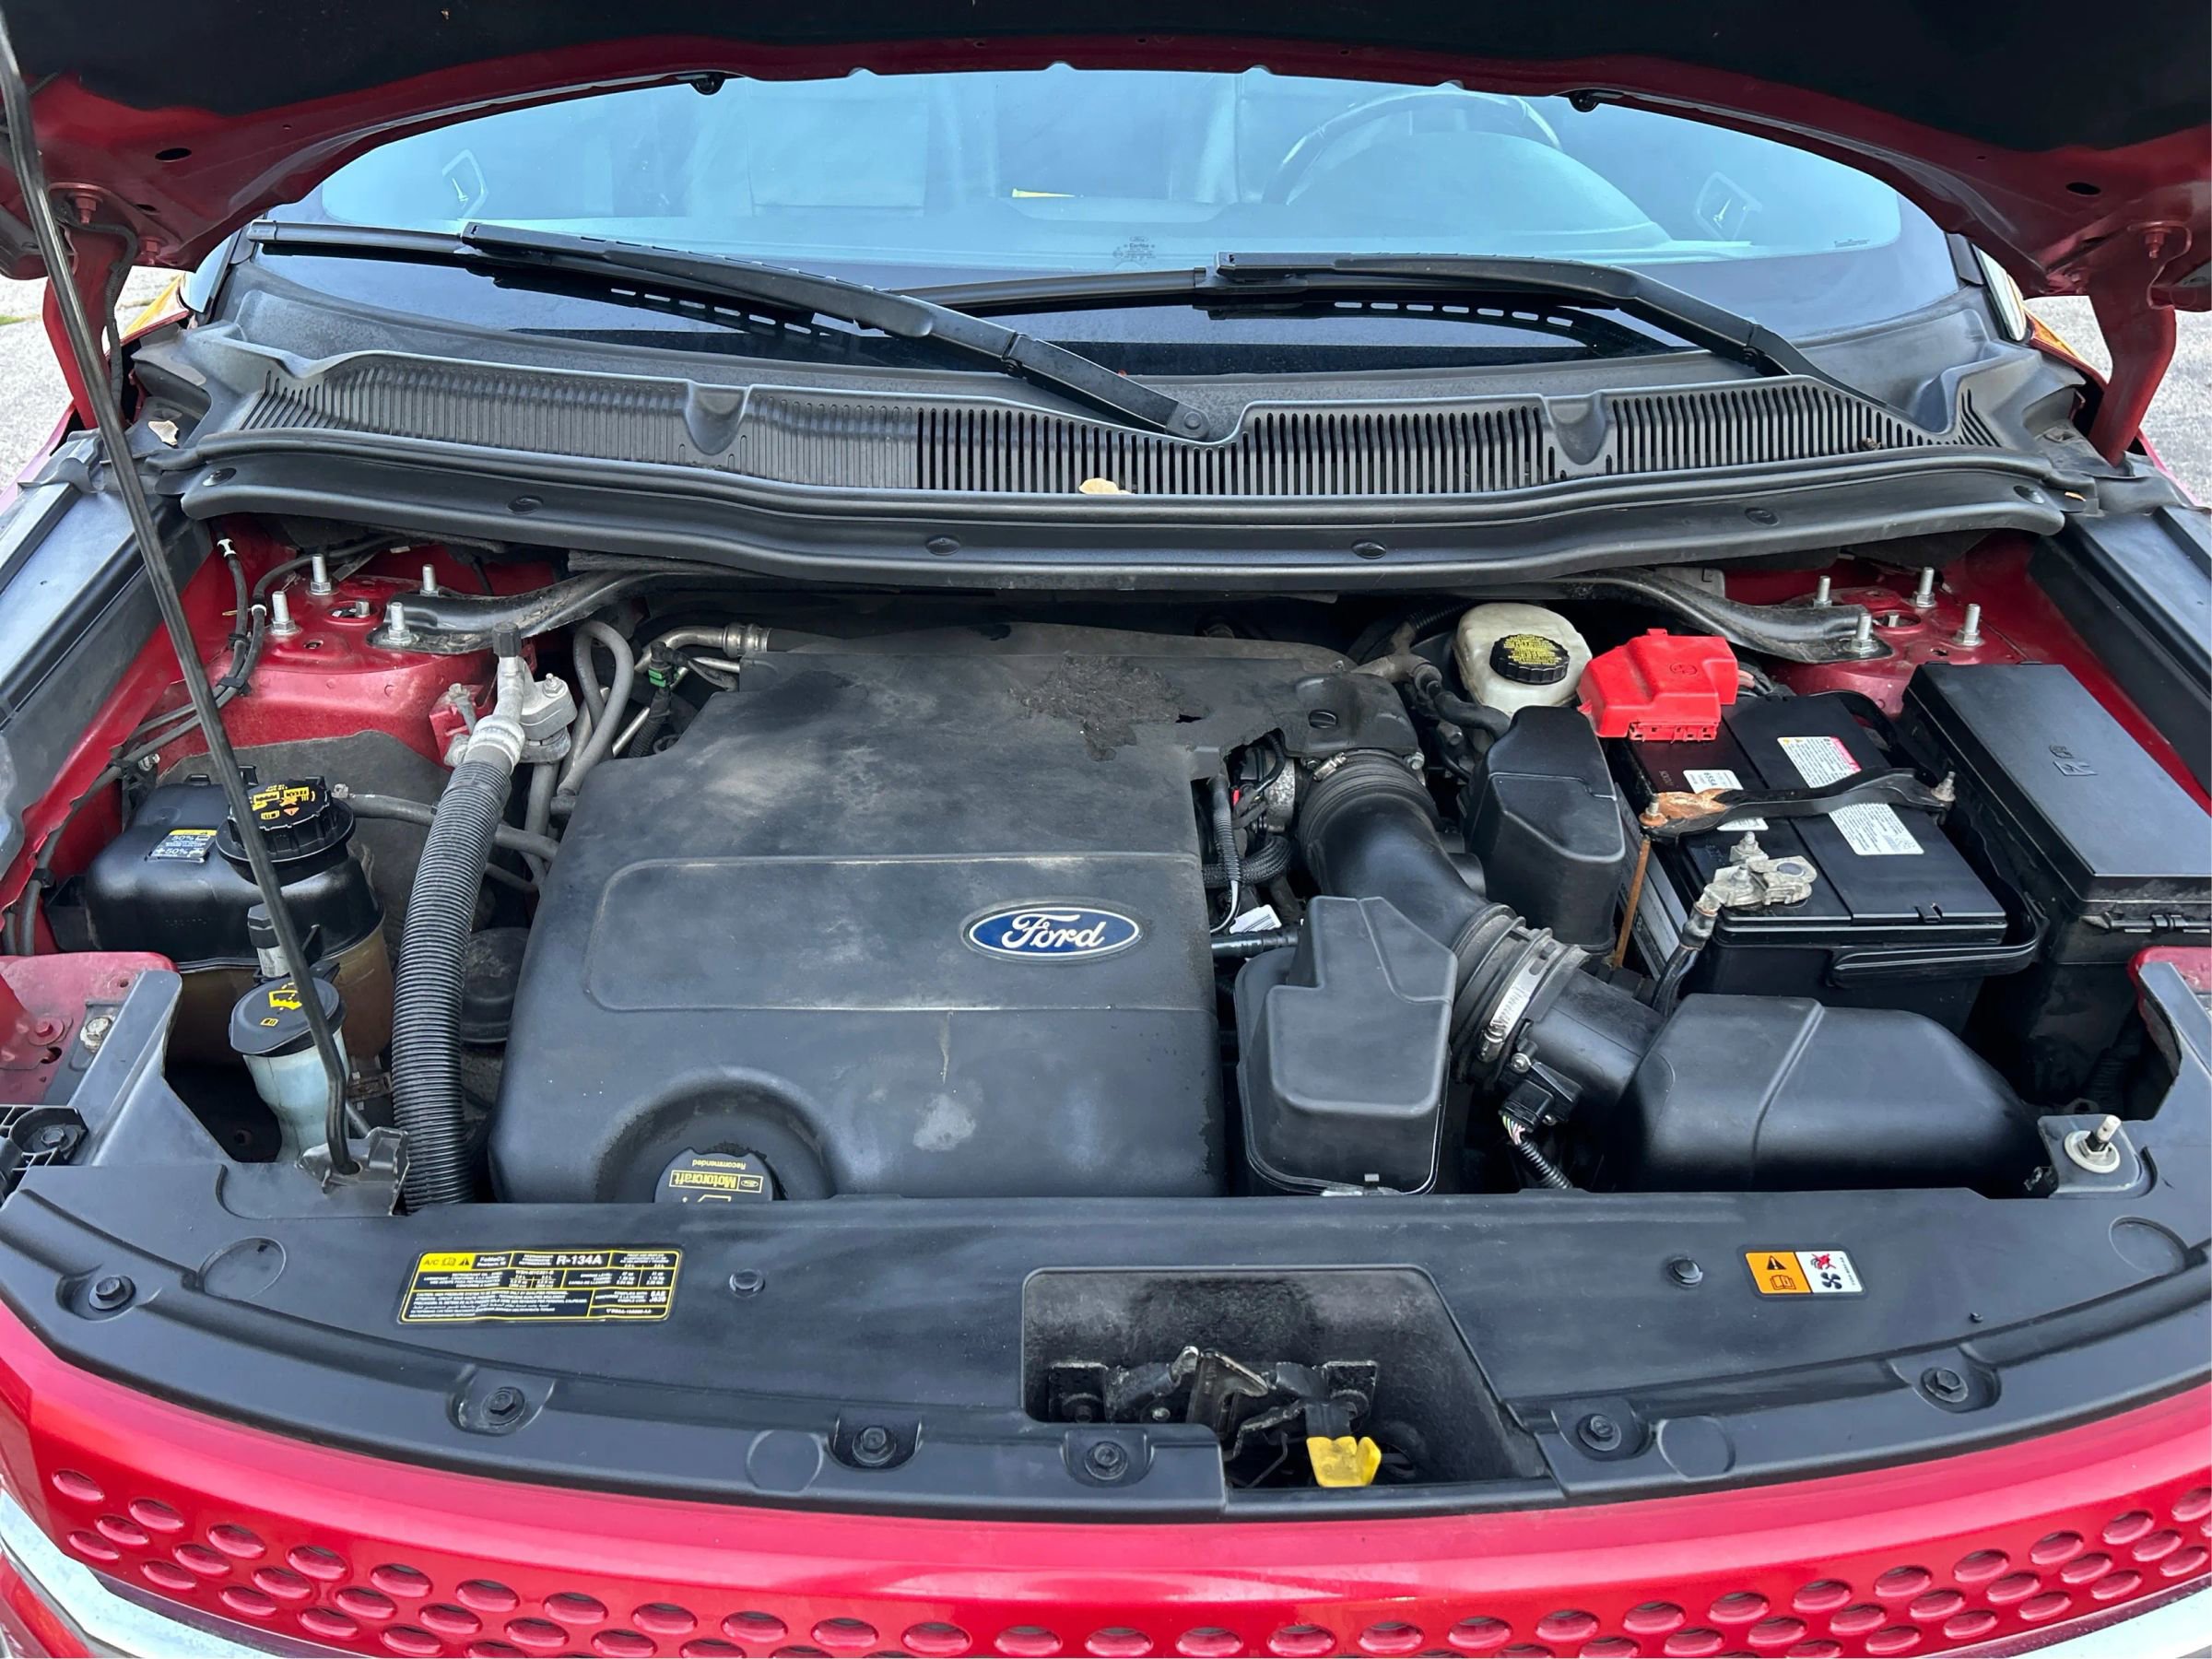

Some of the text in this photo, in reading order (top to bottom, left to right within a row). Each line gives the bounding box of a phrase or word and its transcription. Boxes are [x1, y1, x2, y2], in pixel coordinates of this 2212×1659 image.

[1001, 912, 1107, 948] Ford
[692, 1159, 747, 1171] Recommended
[675, 1172, 737, 1189] Motorcraft
[556, 1254, 603, 1265] R-134A
